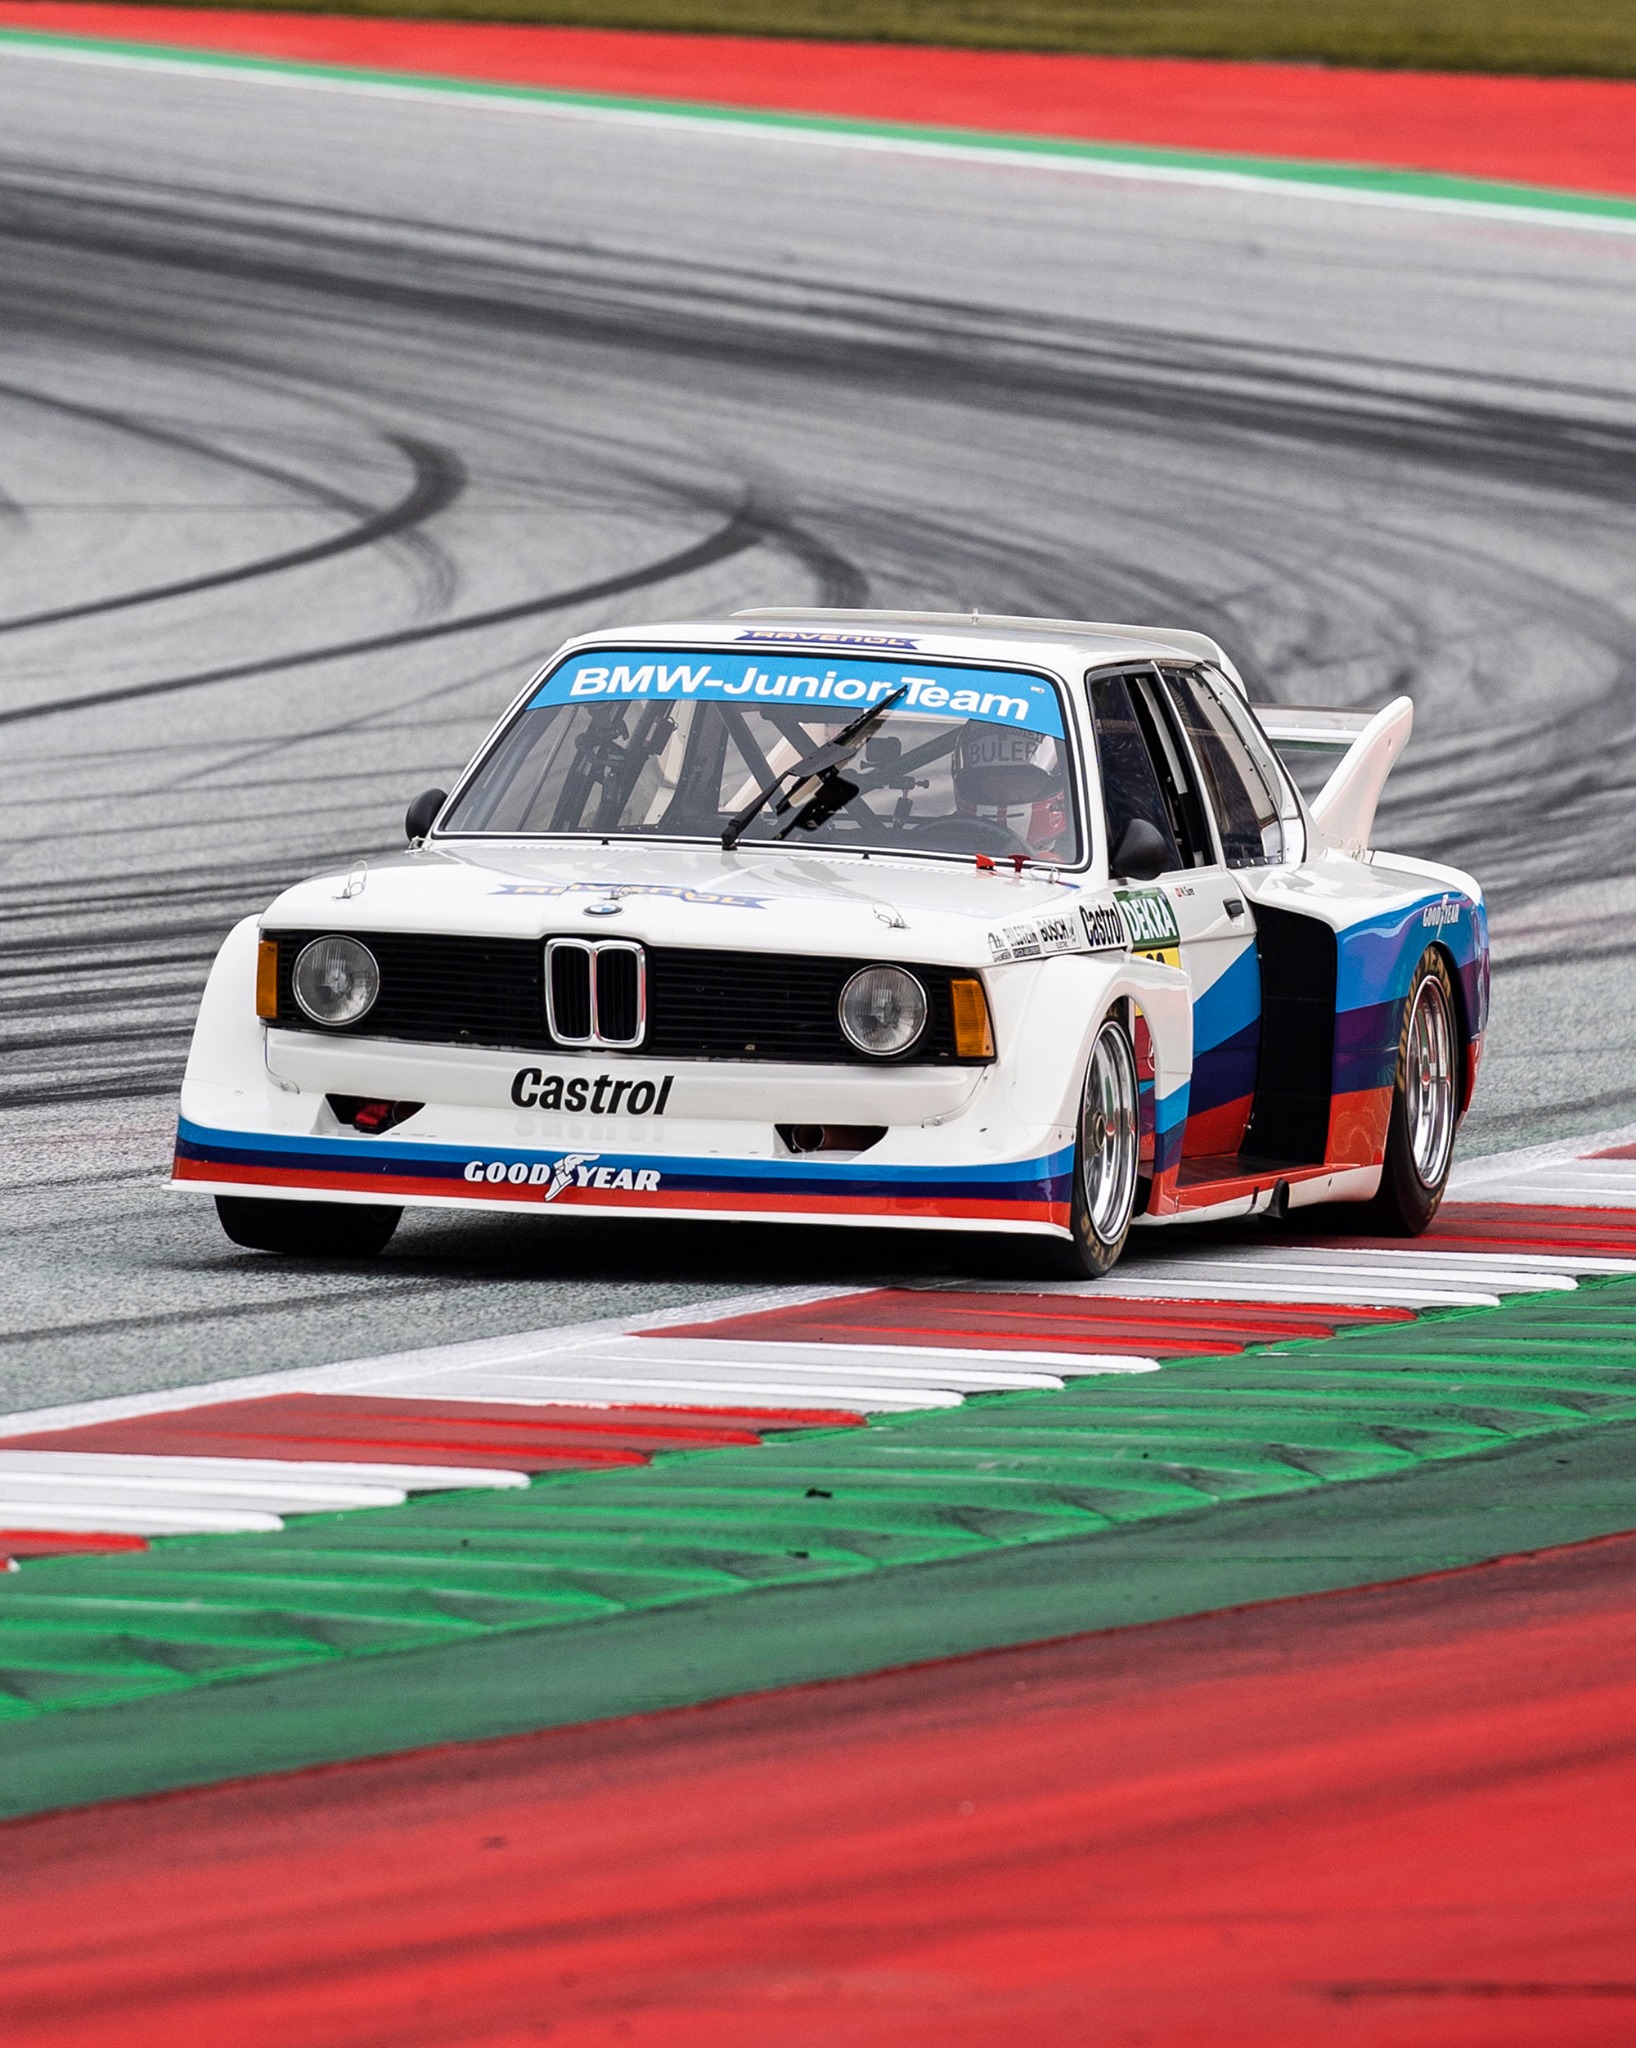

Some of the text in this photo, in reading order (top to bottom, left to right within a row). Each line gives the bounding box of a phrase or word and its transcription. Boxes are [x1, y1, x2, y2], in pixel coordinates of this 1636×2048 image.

[752, 631, 905, 646] RAVENOL
[1079, 902, 1125, 947] Castrol
[1120, 895, 1178, 941] DEKRA
[511, 1067, 675, 1116] Castrol
